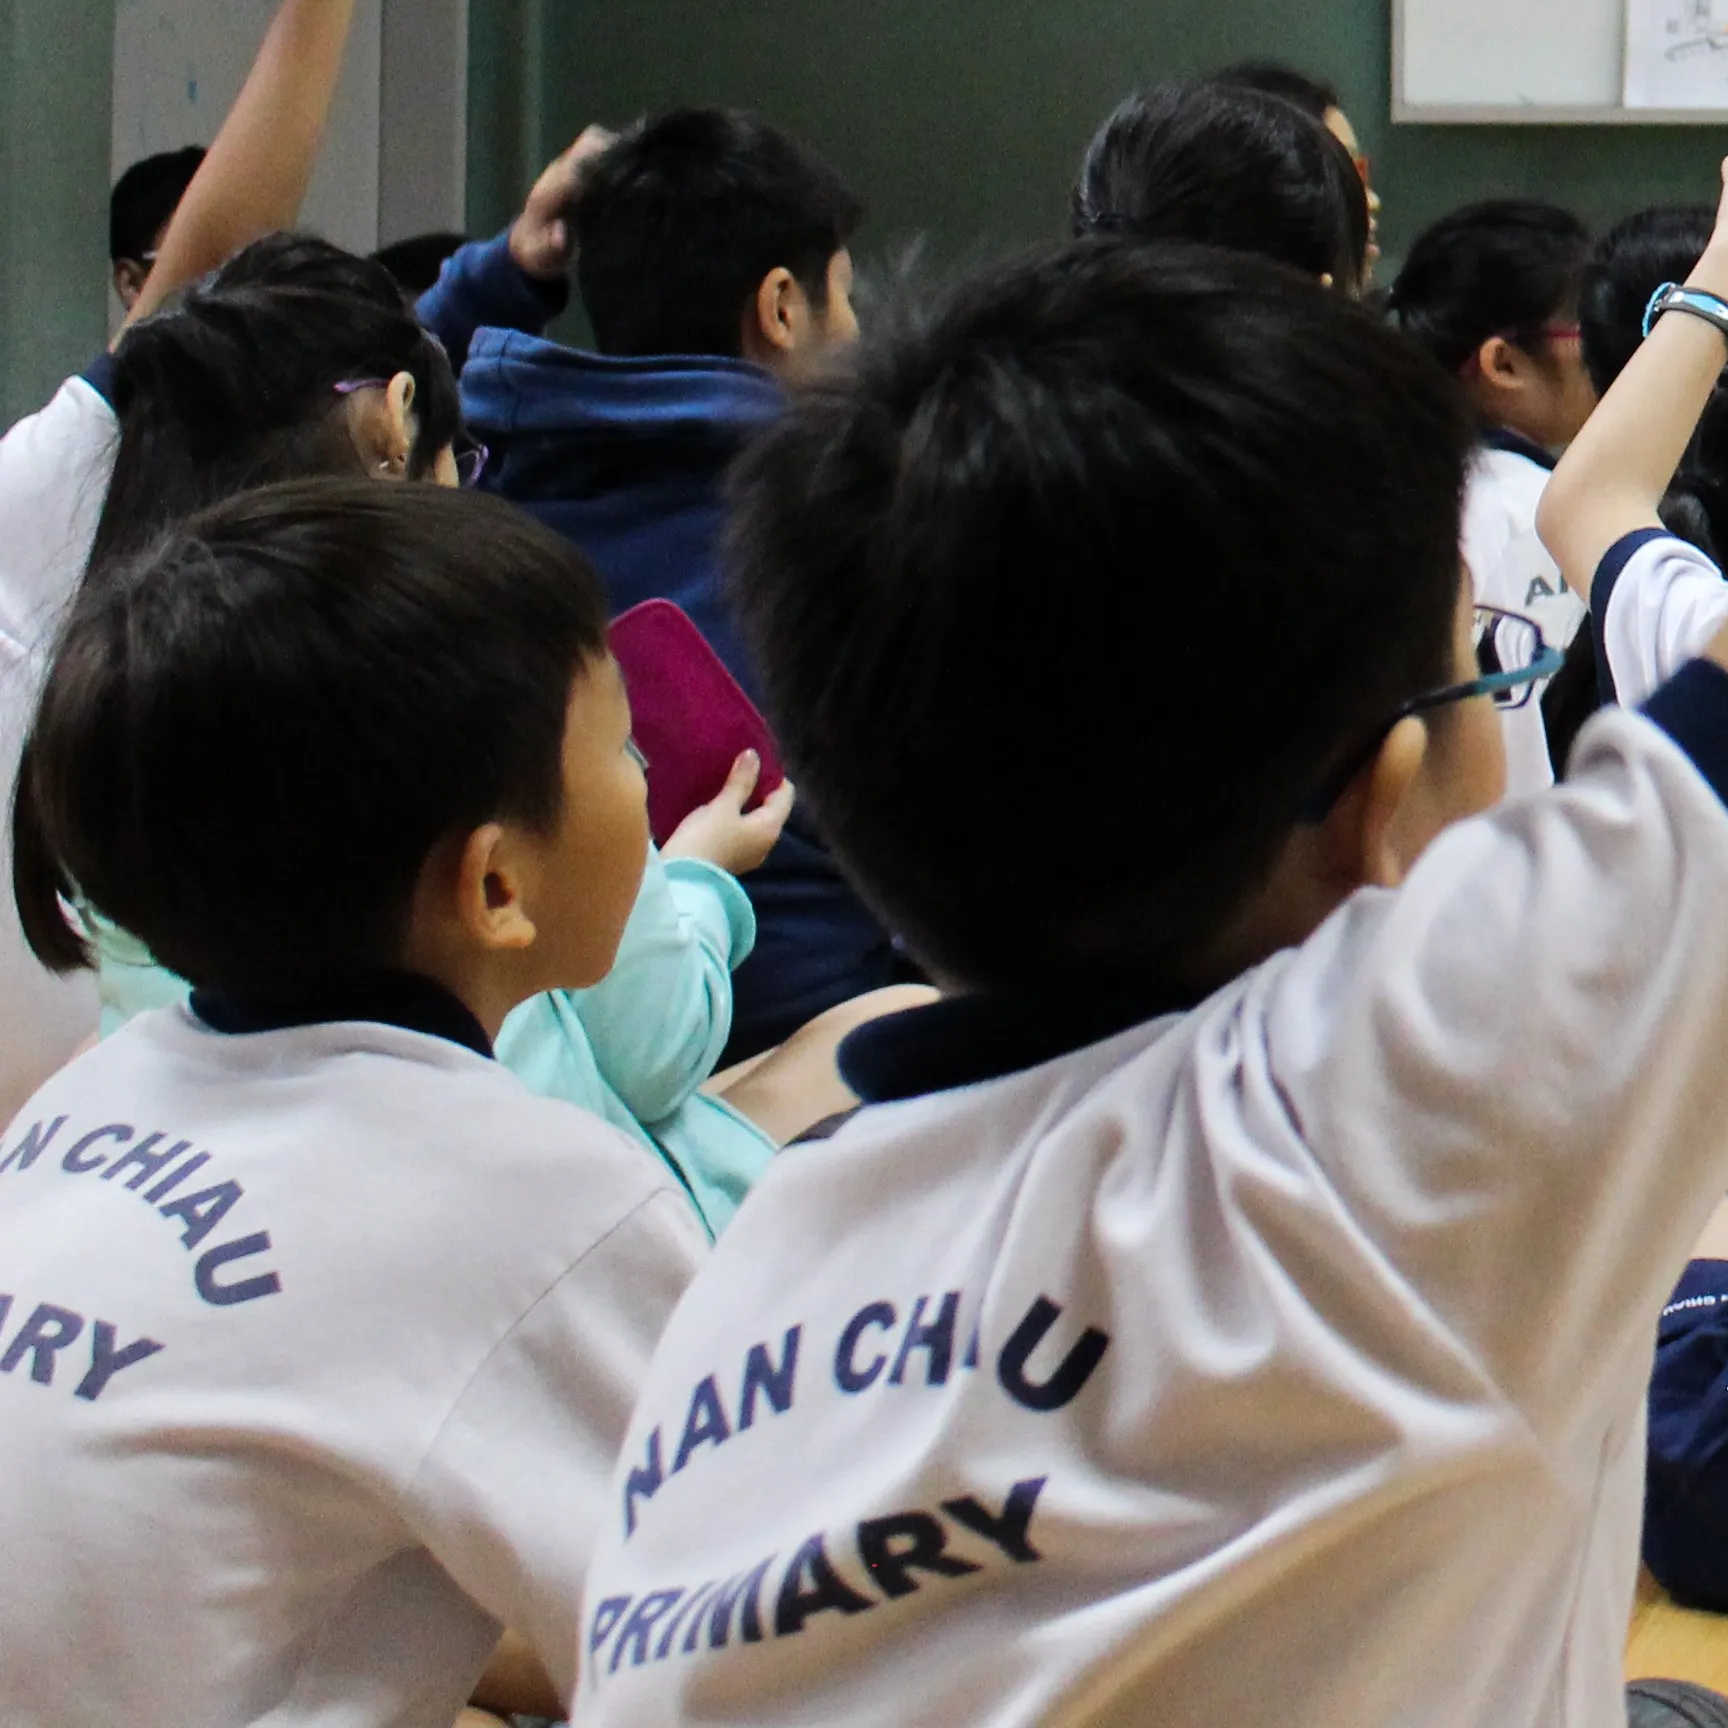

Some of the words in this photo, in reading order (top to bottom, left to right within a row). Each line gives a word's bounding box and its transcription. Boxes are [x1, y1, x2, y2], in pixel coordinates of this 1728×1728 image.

[60, 1122, 284, 1306] CHIAU
[0, 1291, 168, 1402] RY
[624, 1323, 804, 1542] NAN
[589, 1475, 1049, 1673] PRIMARY
